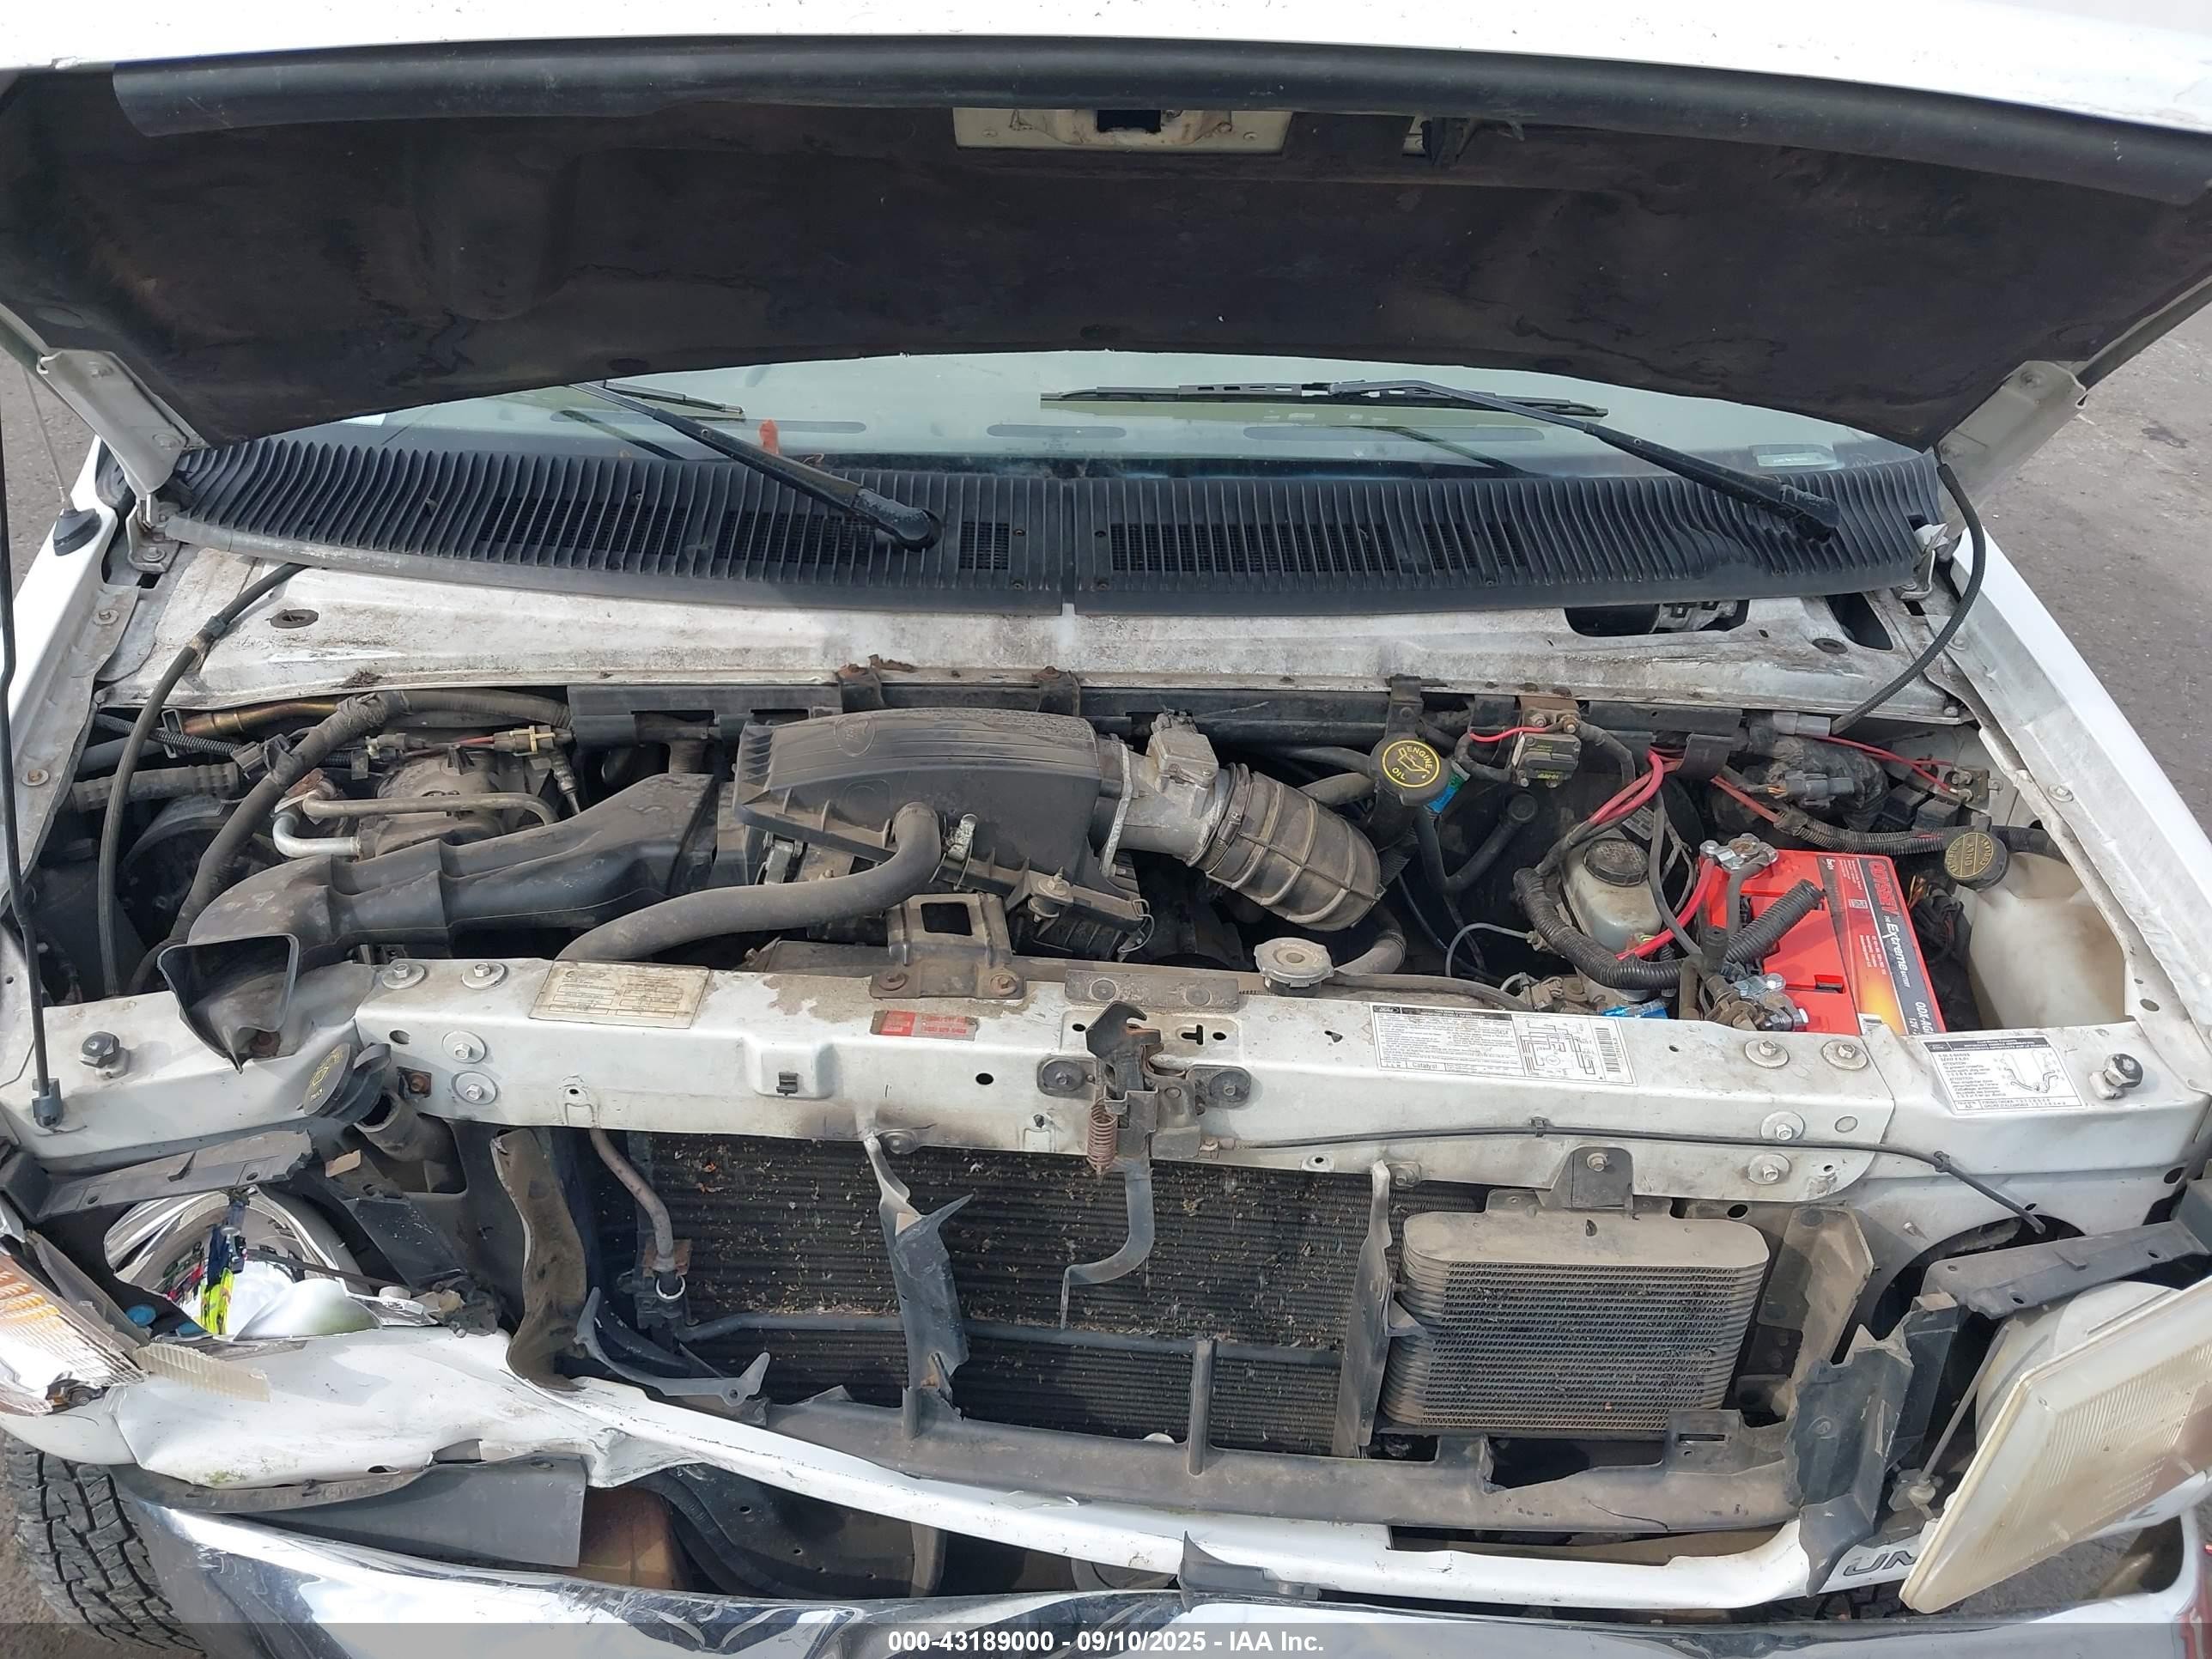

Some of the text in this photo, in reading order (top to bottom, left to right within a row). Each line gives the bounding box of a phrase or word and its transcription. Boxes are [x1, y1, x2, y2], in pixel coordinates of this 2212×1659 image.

[1407, 746, 1433, 769] ENGINE
[1391, 767, 1406, 781] OIL
[1964, 844, 1974, 866] ONLY
[1979, 838, 1991, 866] COOLANT
[1868, 861, 1899, 916] ODYSSEY
[1882, 923, 1908, 972] Extreme
[1908, 1018, 1919, 1029] 12V
